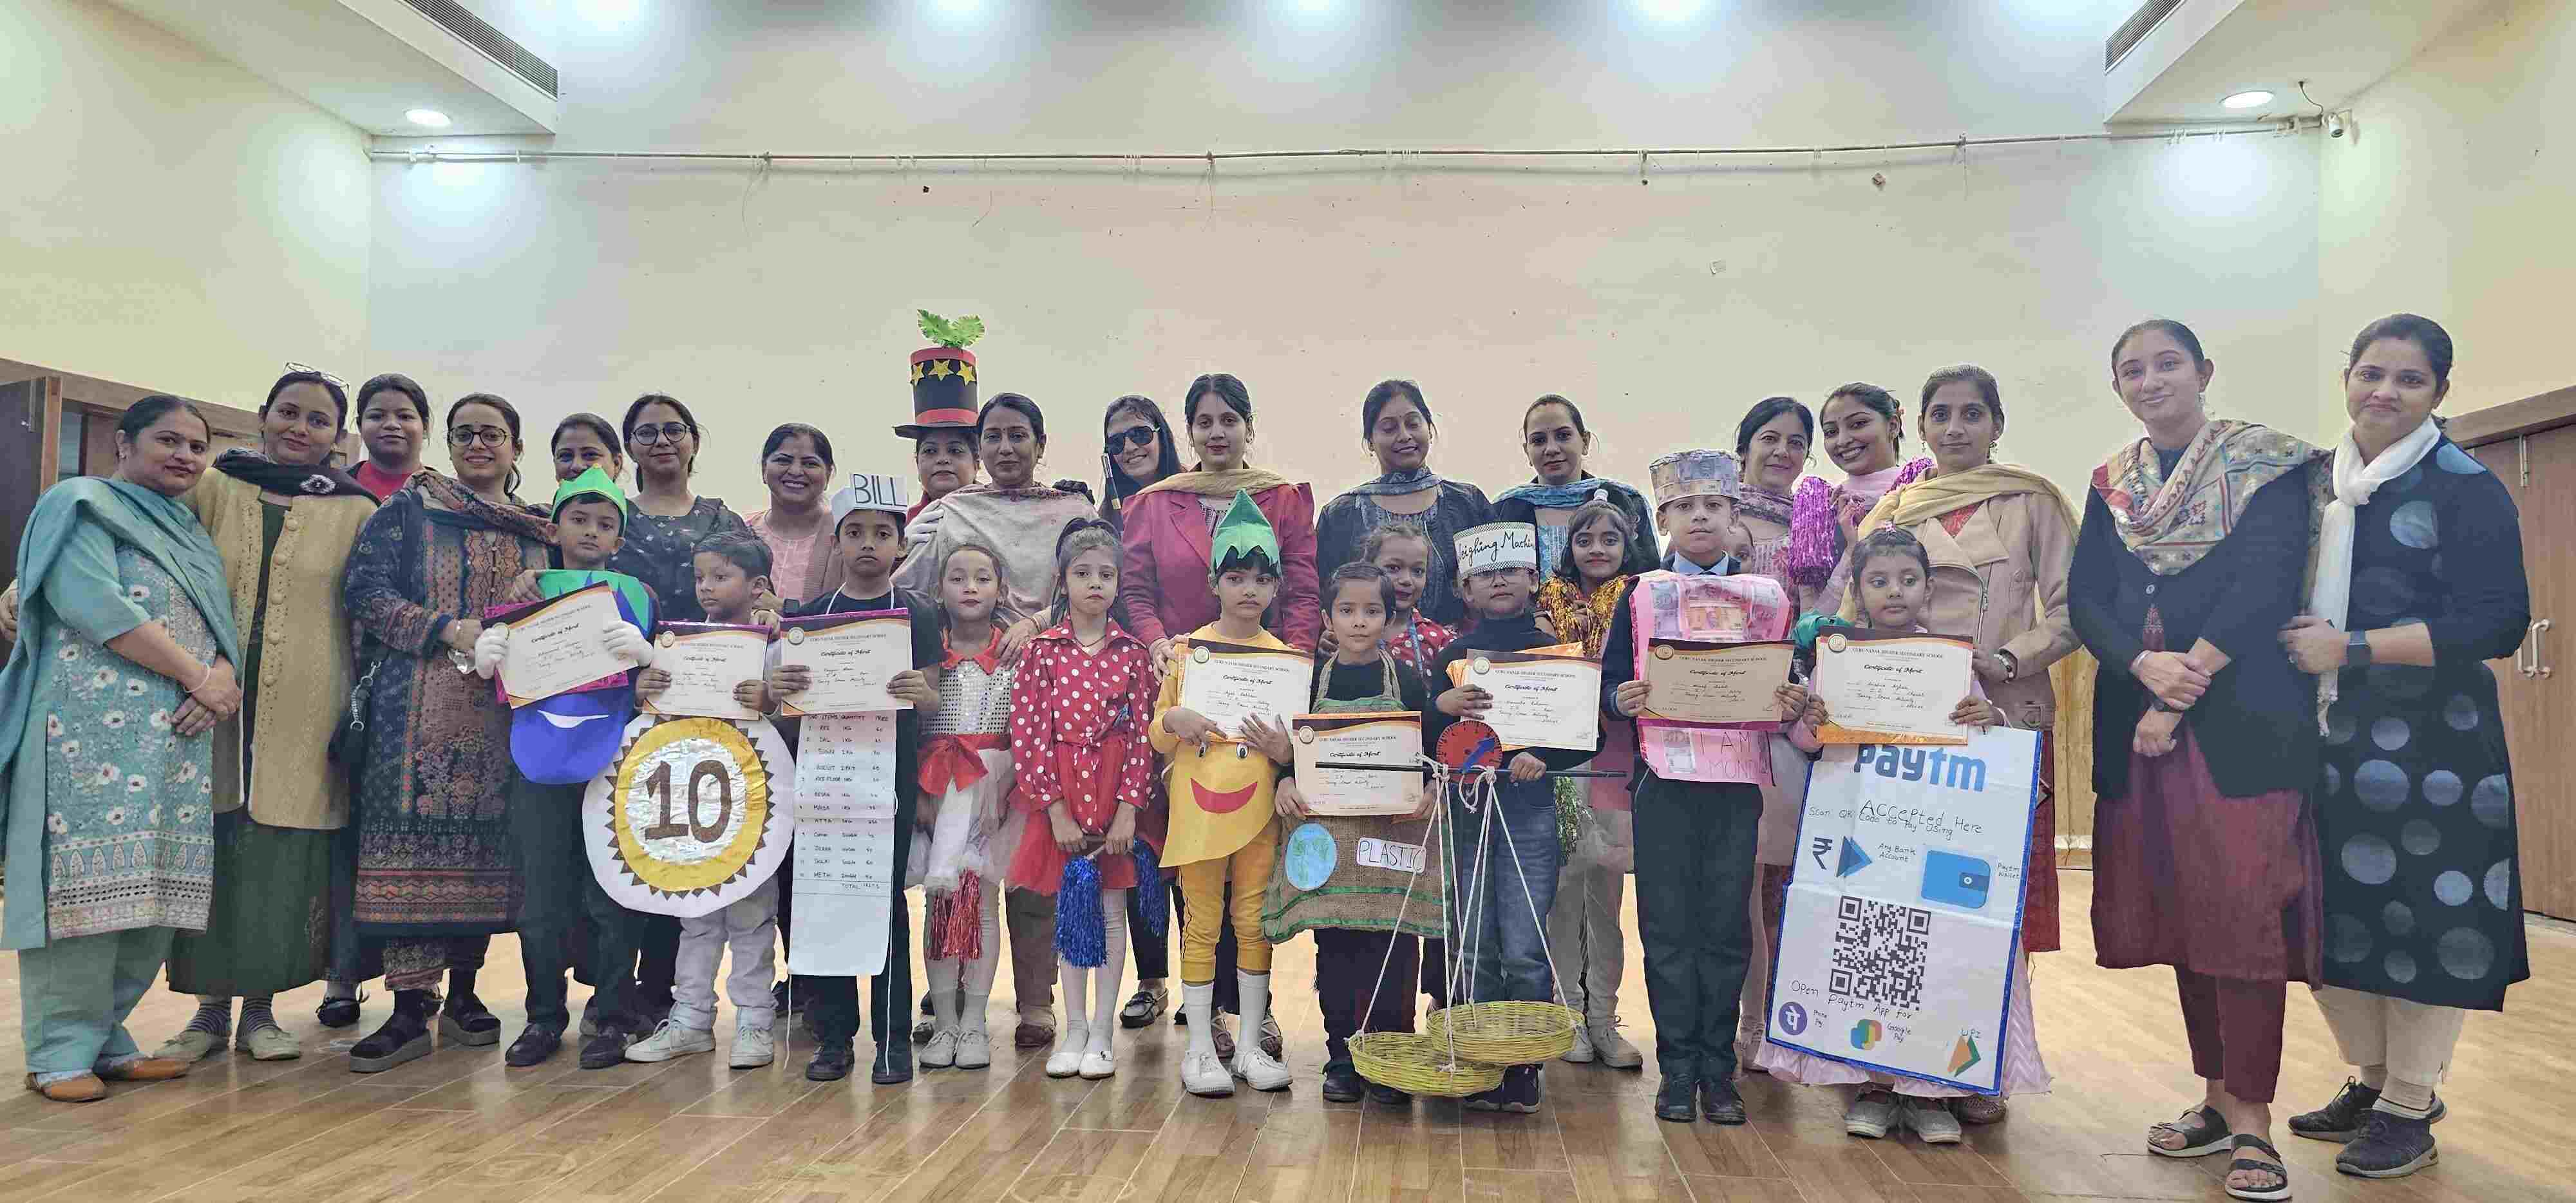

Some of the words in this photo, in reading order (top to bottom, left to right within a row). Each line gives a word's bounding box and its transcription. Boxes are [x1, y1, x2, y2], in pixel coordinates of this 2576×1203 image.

[853, 473, 907, 507] BILL
[645, 760, 732, 843] 10
[1358, 840, 1424, 871] PLASTIC
